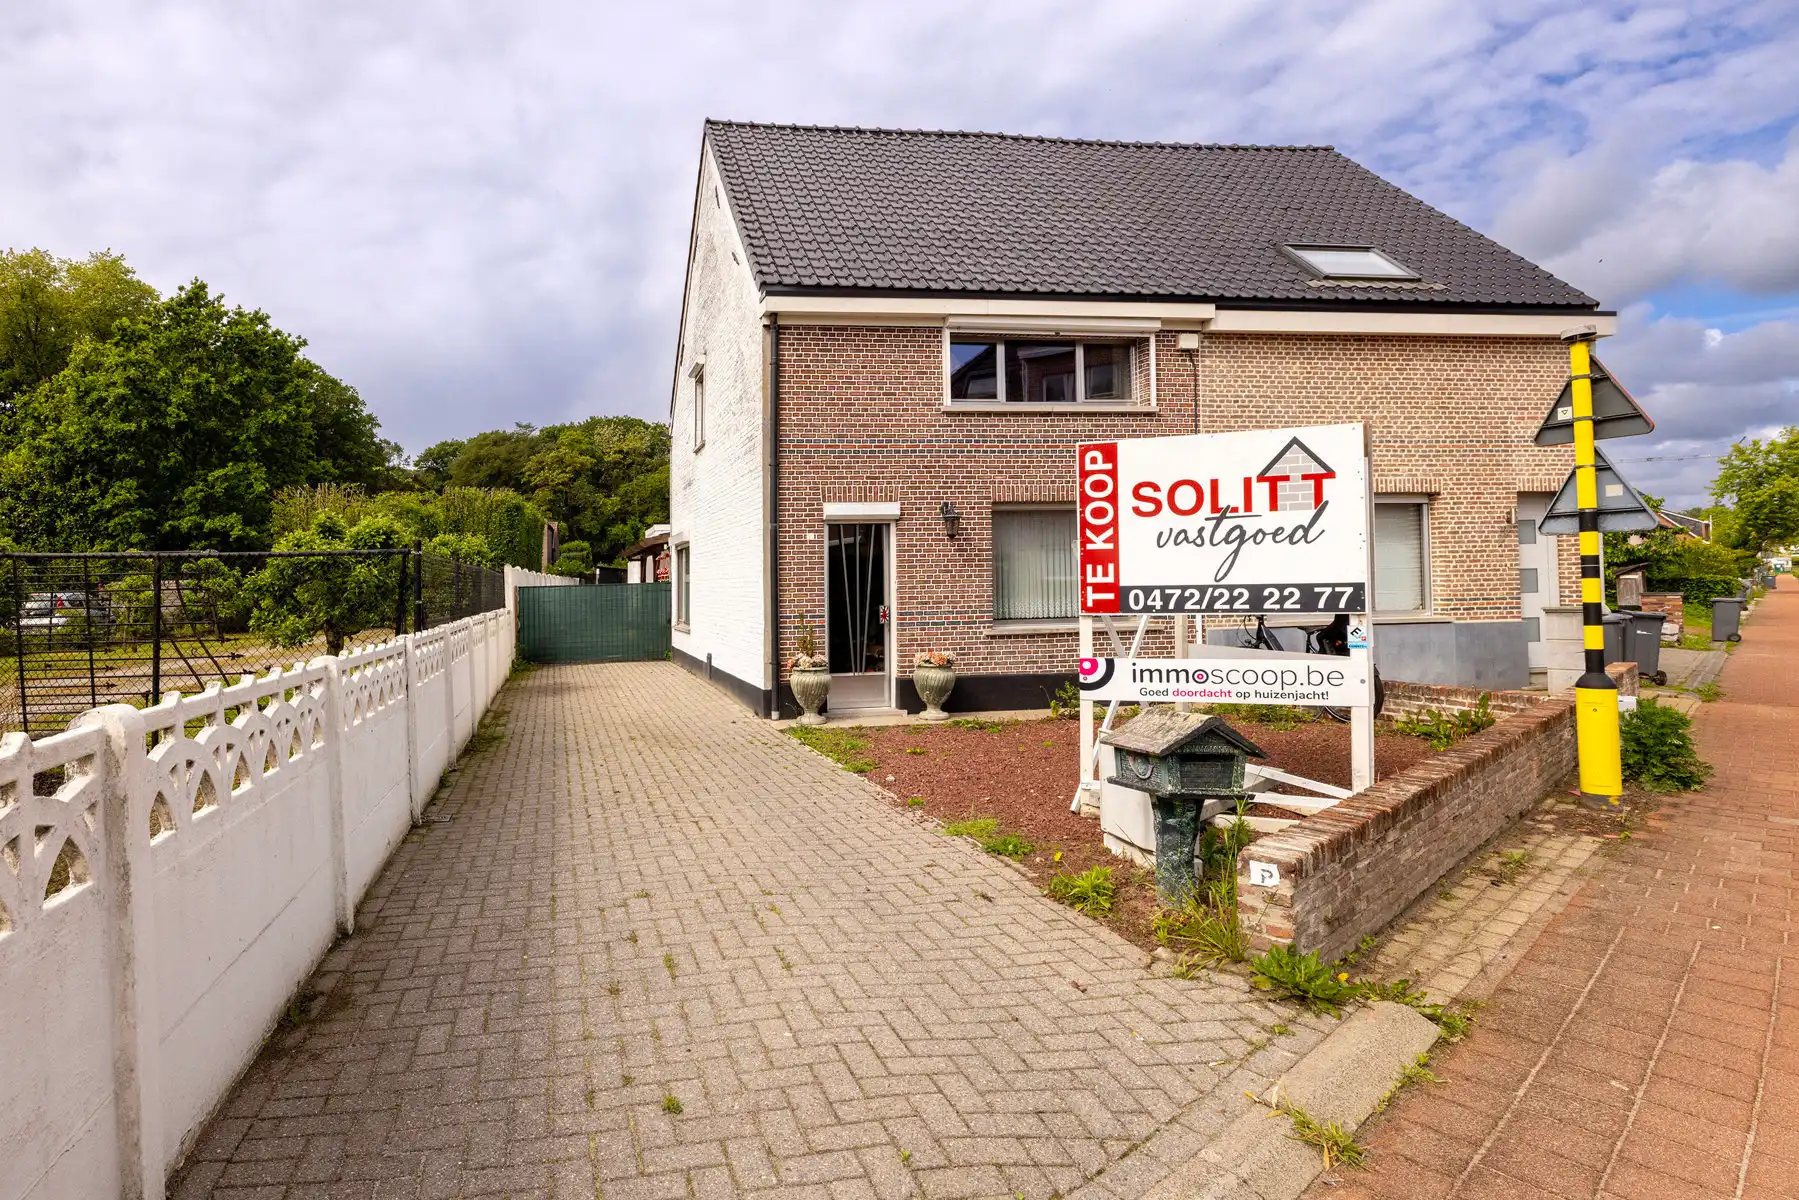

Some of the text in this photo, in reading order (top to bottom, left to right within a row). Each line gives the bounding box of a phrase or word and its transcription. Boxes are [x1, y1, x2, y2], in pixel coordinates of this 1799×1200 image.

[1131, 472, 1336, 518] SOLITT
[1084, 450, 1115, 607] TE KOOP
[1156, 500, 1330, 583] vastgoed
[1128, 586, 1354, 610] 0472/22 22 77
[1132, 662, 1345, 690] immoscoop.be
[1139, 687, 1329, 701] Goed doordacht op huizenjacht!
[1261, 868, 1274, 884] P
